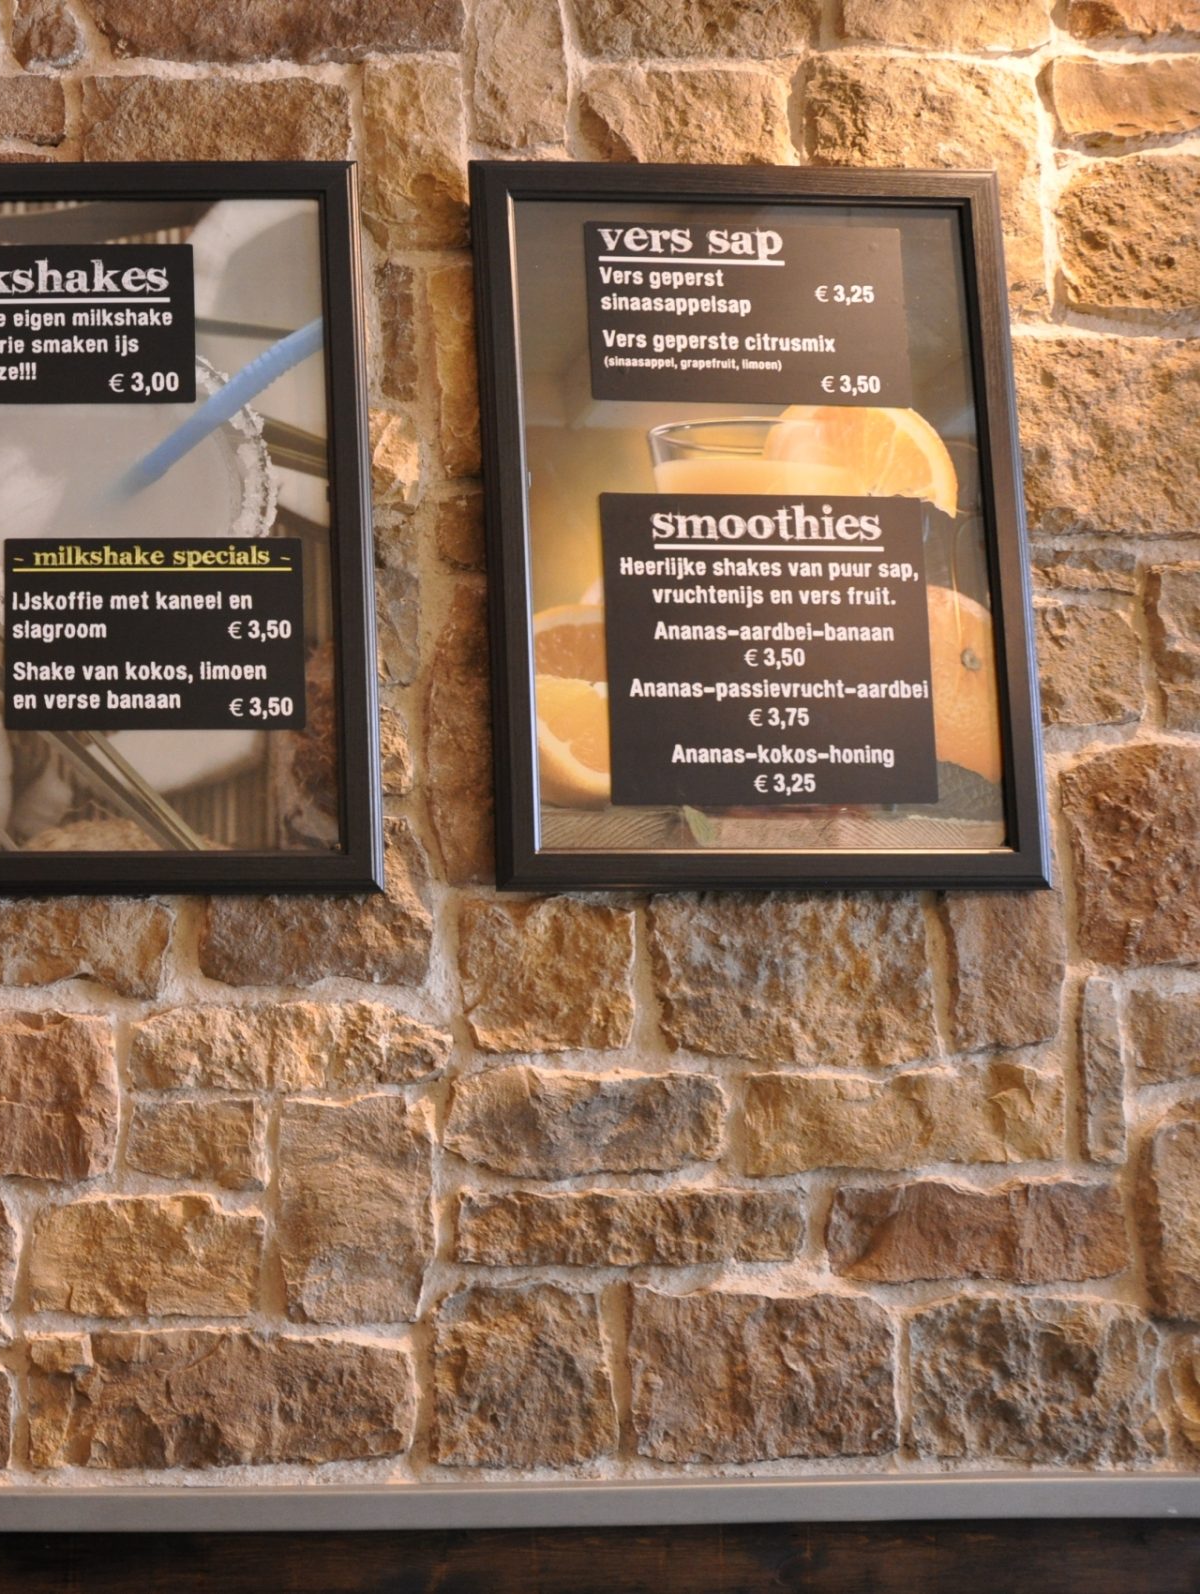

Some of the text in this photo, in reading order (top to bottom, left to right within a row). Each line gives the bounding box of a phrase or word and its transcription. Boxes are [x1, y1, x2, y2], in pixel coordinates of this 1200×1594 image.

[598, 227, 783, 262] vers sap
[599, 266, 724, 290] Vers geperst
[600, 292, 752, 317] sinaasappelsap
[833, 284, 875, 306] 3,25
[12, 310, 66, 331] eigen
[72, 308, 174, 327] milkshake
[31, 335, 109, 354] smaken
[115, 335, 140, 357] ijs
[602, 329, 836, 353] Vers geperste citrusmix
[604, 355, 783, 372] (sinaasappel, grapefruit, limoen)
[130, 371, 180, 396] 3,00
[839, 374, 881, 396] 3,50
[650, 503, 883, 542] smoothies
[33, 544, 271, 570] milkshake specials
[619, 556, 919, 582] Heerlijke shakes van puur sap,
[12, 590, 253, 611] IJskoffie met kaneel en
[652, 585, 897, 609] vruchtenijs en vers fruit.
[12, 619, 108, 643] slagroom
[247, 619, 292, 643] 3,50
[653, 620, 895, 642] Ananas-aardbei-banaan
[763, 647, 806, 670] 3,50
[12, 660, 268, 684] Shake van kokos, limoen
[12, 689, 182, 710] en verse banaan
[629, 677, 929, 702] Ananas-passievrucht-aardbei
[248, 696, 294, 720] 3,50
[767, 707, 810, 730] 3,75
[671, 743, 895, 769] Ananas-kokos-honing
[772, 772, 817, 797] 3,25
